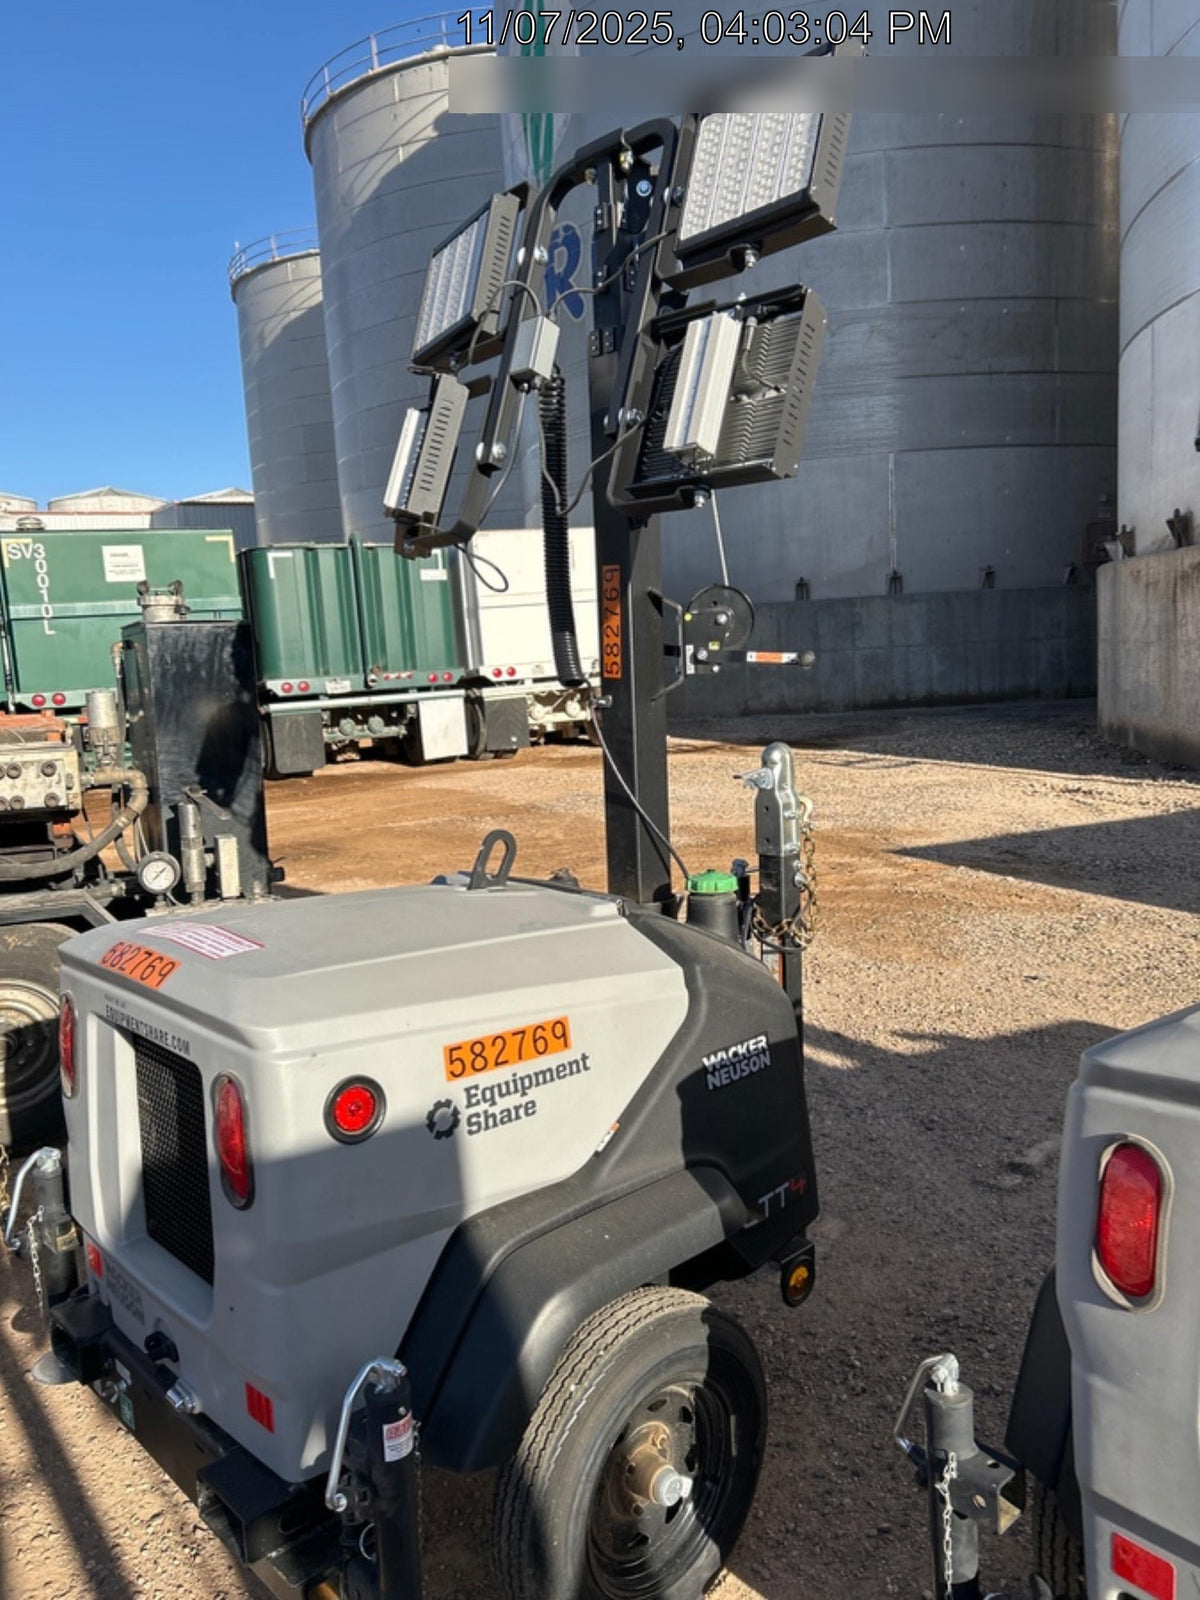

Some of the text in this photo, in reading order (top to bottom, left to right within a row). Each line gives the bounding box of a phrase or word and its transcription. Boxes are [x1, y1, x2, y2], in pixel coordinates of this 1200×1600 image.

[603, 567, 620, 676] 582769
[447, 1019, 569, 1079] 582769
[701, 1034, 769, 1073] WACKER
[706, 1049, 772, 1092] NEUSON
[463, 1052, 592, 1111] Equipment
[465, 1099, 538, 1137] Share
